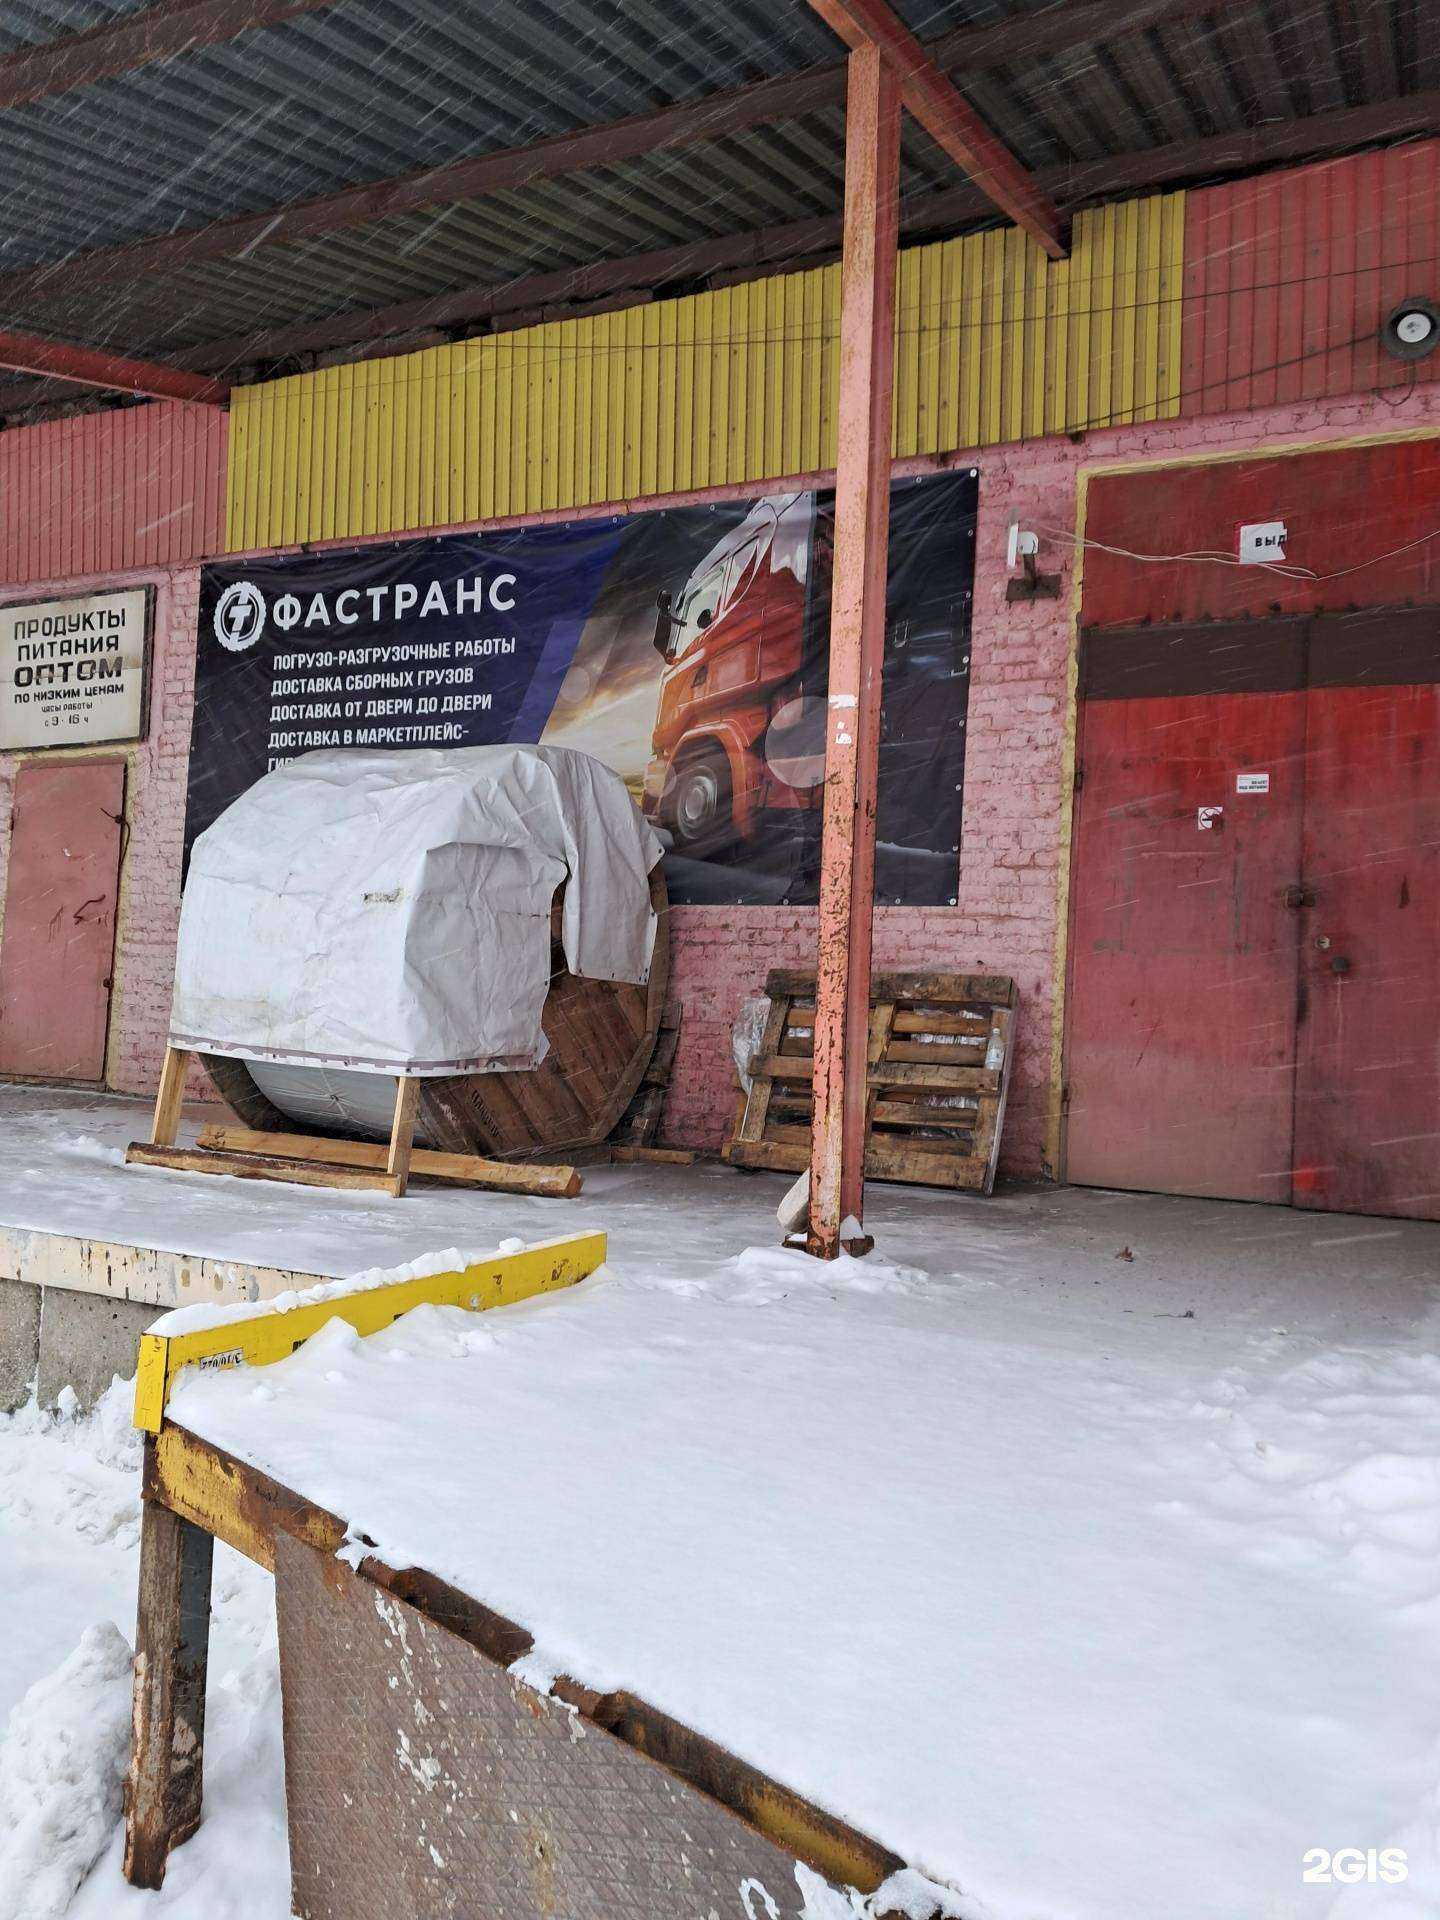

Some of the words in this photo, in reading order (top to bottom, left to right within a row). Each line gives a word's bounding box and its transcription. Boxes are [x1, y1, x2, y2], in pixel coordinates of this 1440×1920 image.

[272, 574, 517, 631] ФАСТРАНС
[14, 608, 126, 640] ПРОДУКТЫ
[17, 635, 119, 662] ПИТАНИЯ
[273, 642, 451, 671] ПОГРУЗО-РАЗГРУЗОЧНЫЕ
[455, 637, 516, 657] РАБОТЫ
[14, 656, 124, 688] ОПТОМ
[271, 674, 342, 696] ДОСТАВКА
[345, 670, 413, 691] СБОРНЫХ
[417, 667, 474, 685] ГРУЗОВ
[14, 693, 30, 704] ПО
[33, 688, 80, 702] НИЗКИМ
[84, 684, 124, 697] ЦЕНАМ
[270, 701, 341, 722] ДОСТАВКА
[345, 701, 361, 717] ОТ
[365, 698, 413, 718] ДВЕРИ
[416, 697, 438, 715] ДО
[441, 694, 492, 714] ДВЕРИ
[268, 728, 339, 749] ДОСТАВКА
[343, 729, 353, 744] В
